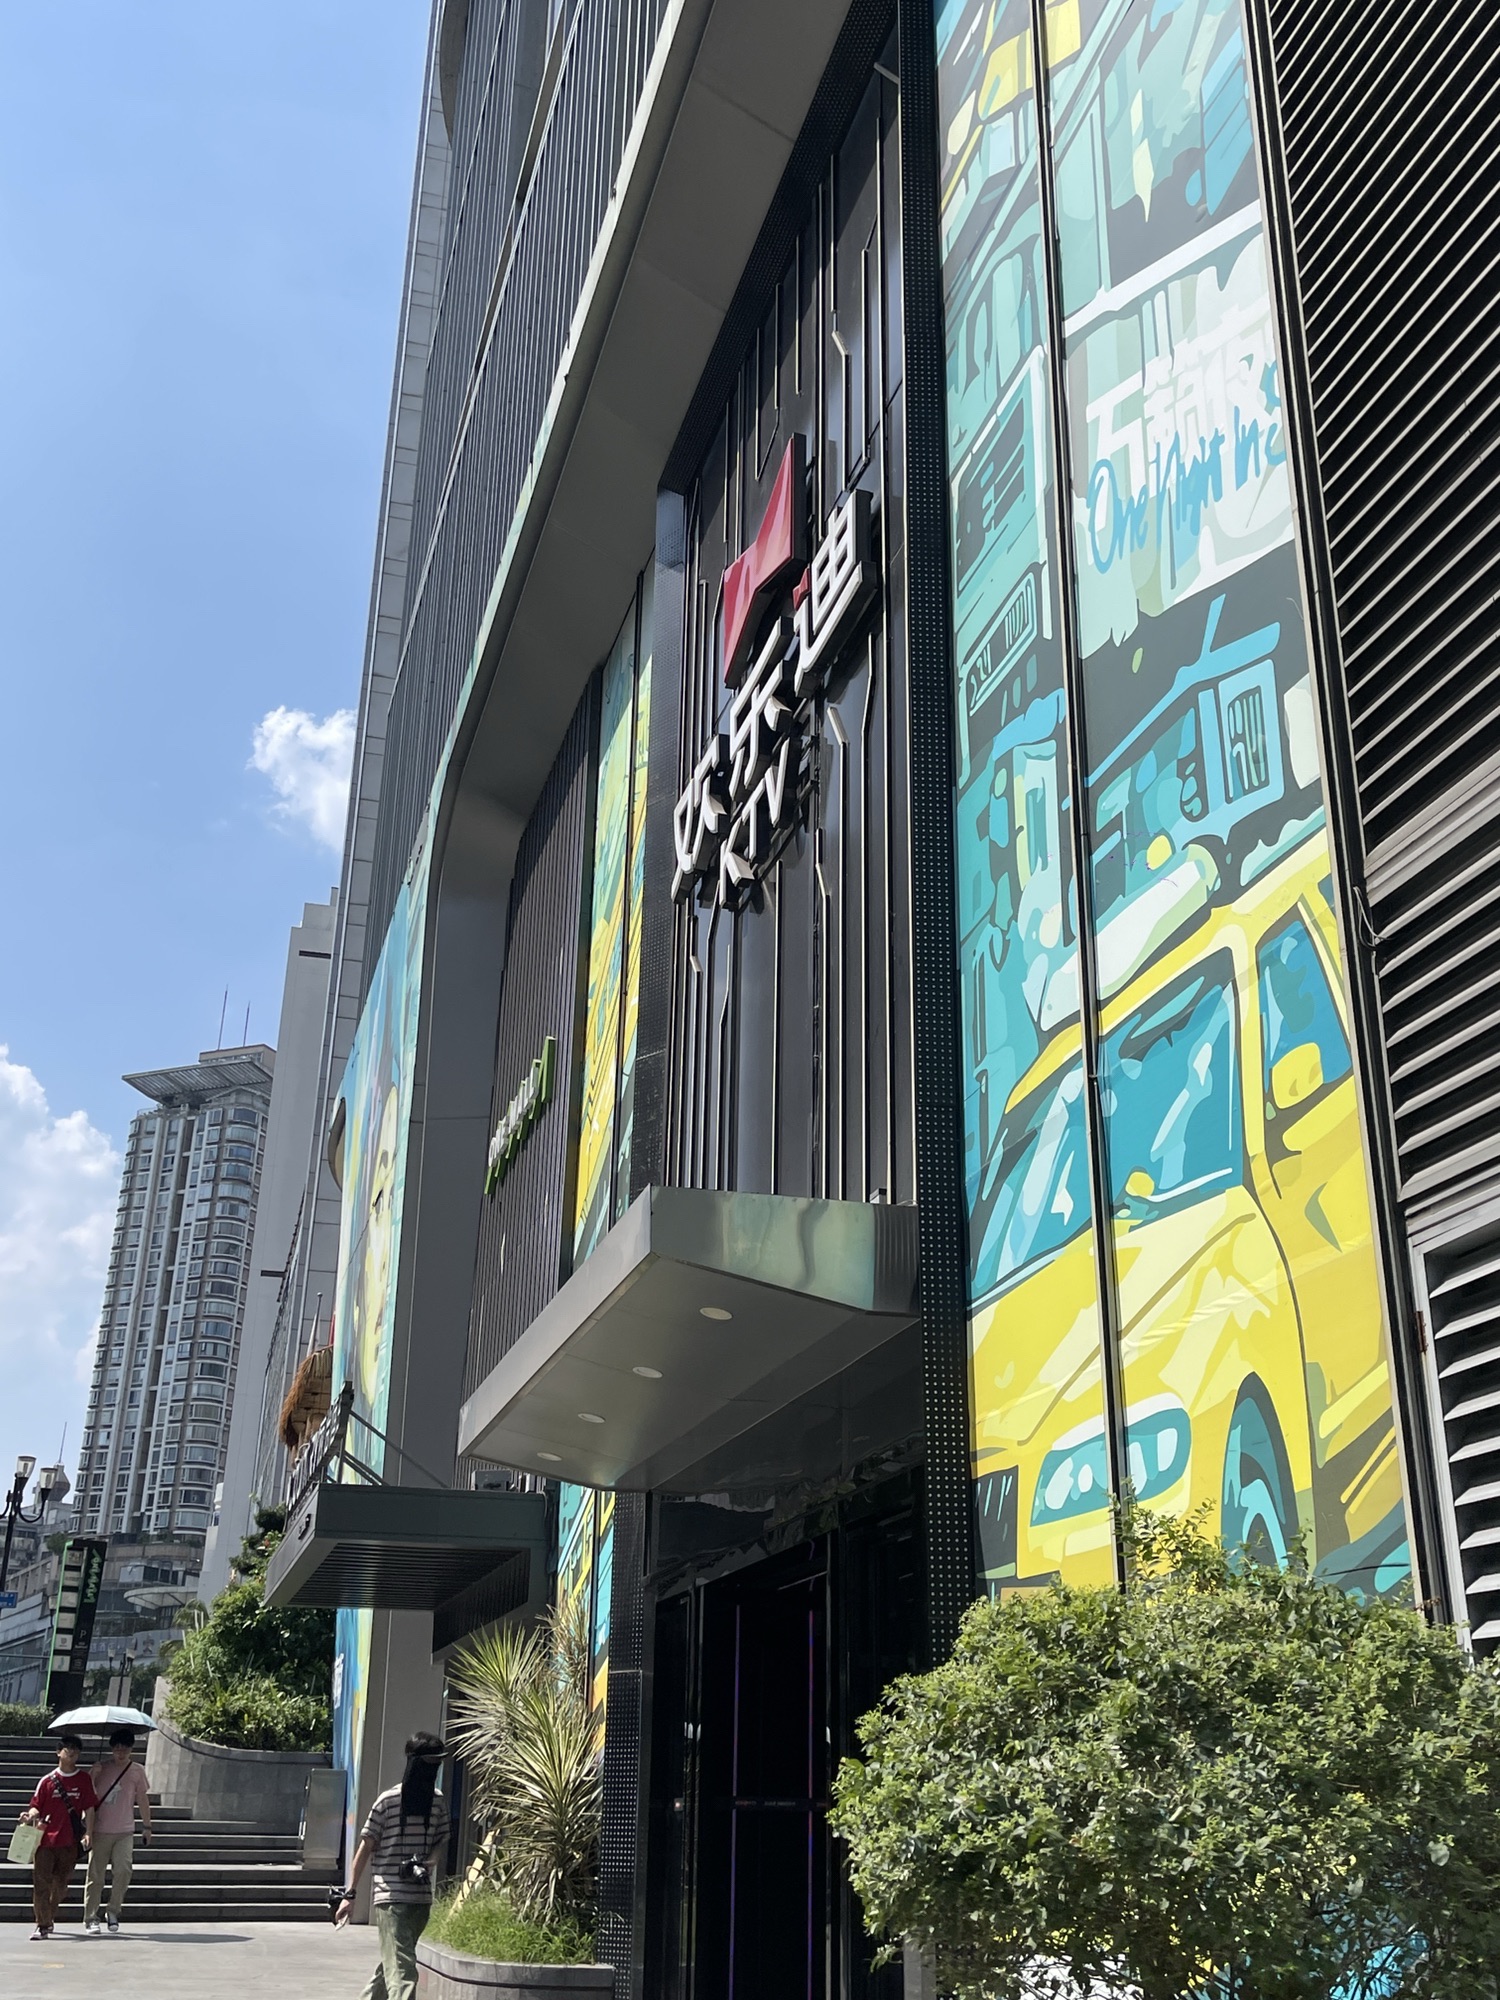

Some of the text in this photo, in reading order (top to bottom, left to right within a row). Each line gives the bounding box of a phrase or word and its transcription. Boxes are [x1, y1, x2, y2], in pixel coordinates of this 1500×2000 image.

[672, 489, 866, 902] 欧乐迪
[719, 738, 794, 909] KTV
